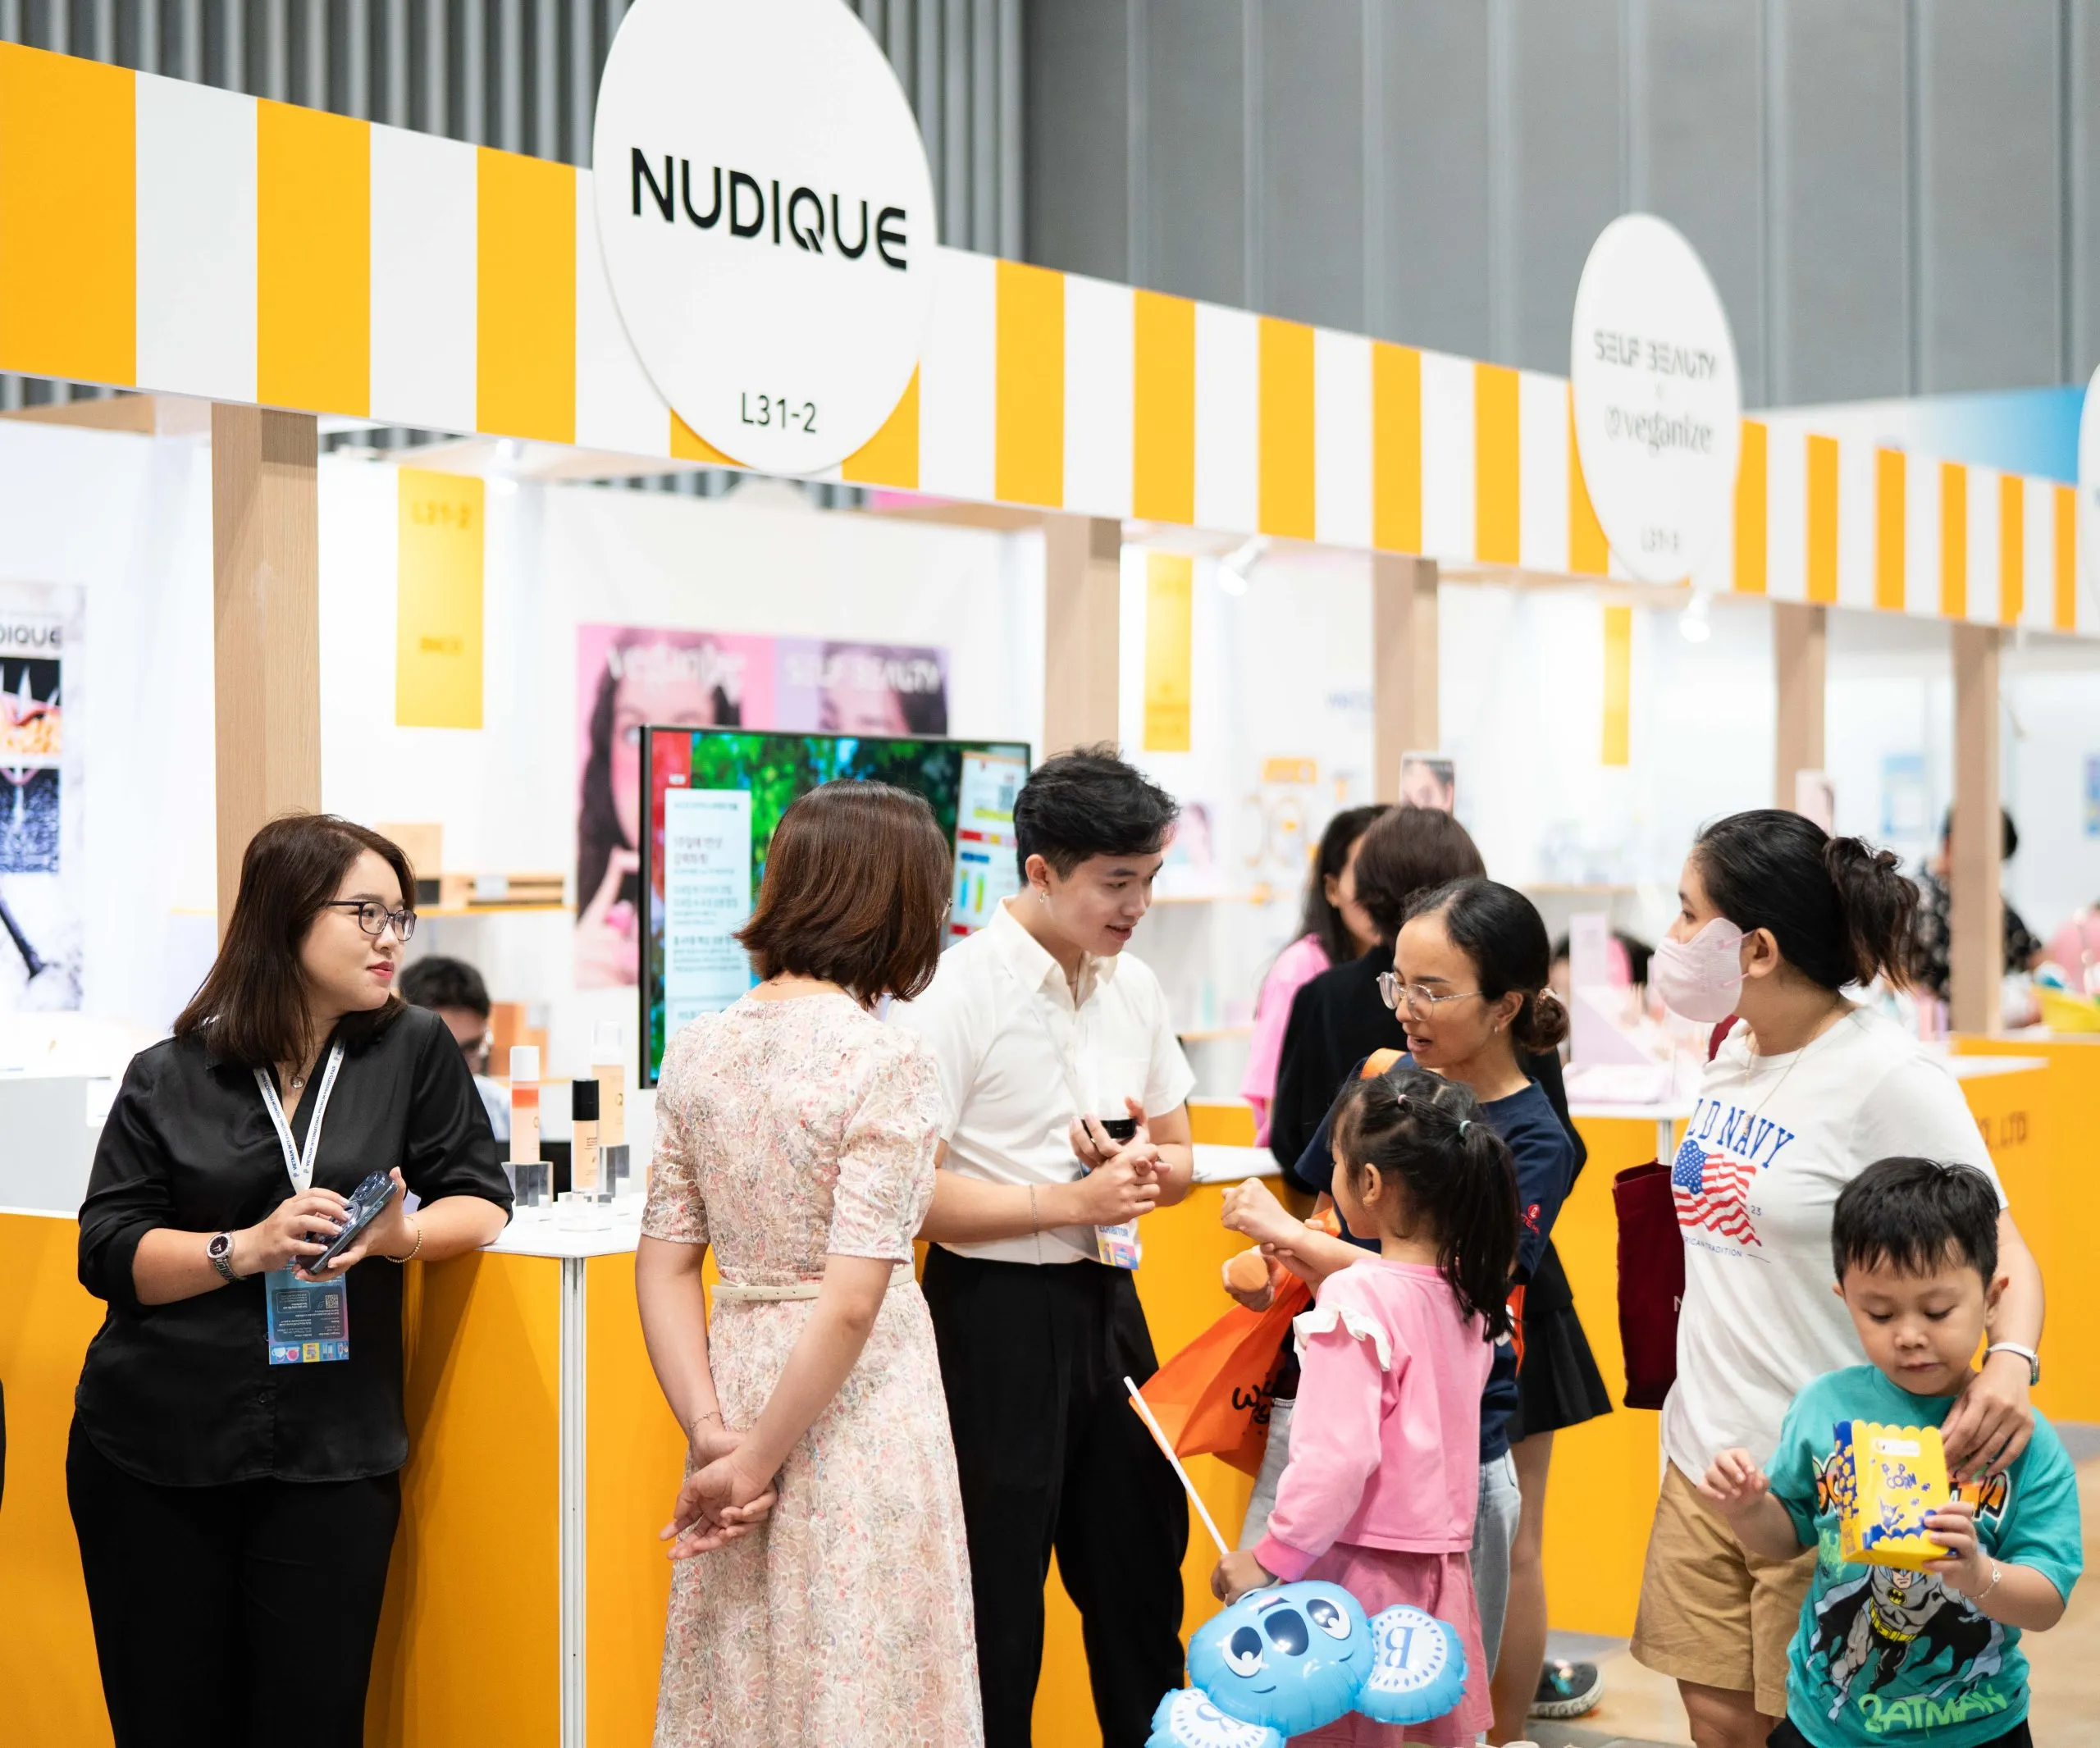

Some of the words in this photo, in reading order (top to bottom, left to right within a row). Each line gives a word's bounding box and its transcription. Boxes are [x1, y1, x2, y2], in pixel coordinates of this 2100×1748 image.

[631, 147, 907, 272] NUDIQUE
[1594, 328, 1639, 367] SELF
[1646, 340, 1717, 380] BEAUTY
[741, 392, 817, 433] L31-2
[1623, 409, 1714, 457] veganize
[311, 1115, 321, 1146] INTERNATIONAL
[324, 1075, 334, 1095] PRODUCTS
[289, 1148, 297, 1171] VIETNAM
[1717, 1107, 1795, 1169] NAVY
[1858, 1684, 2007, 1733] BATMAN
